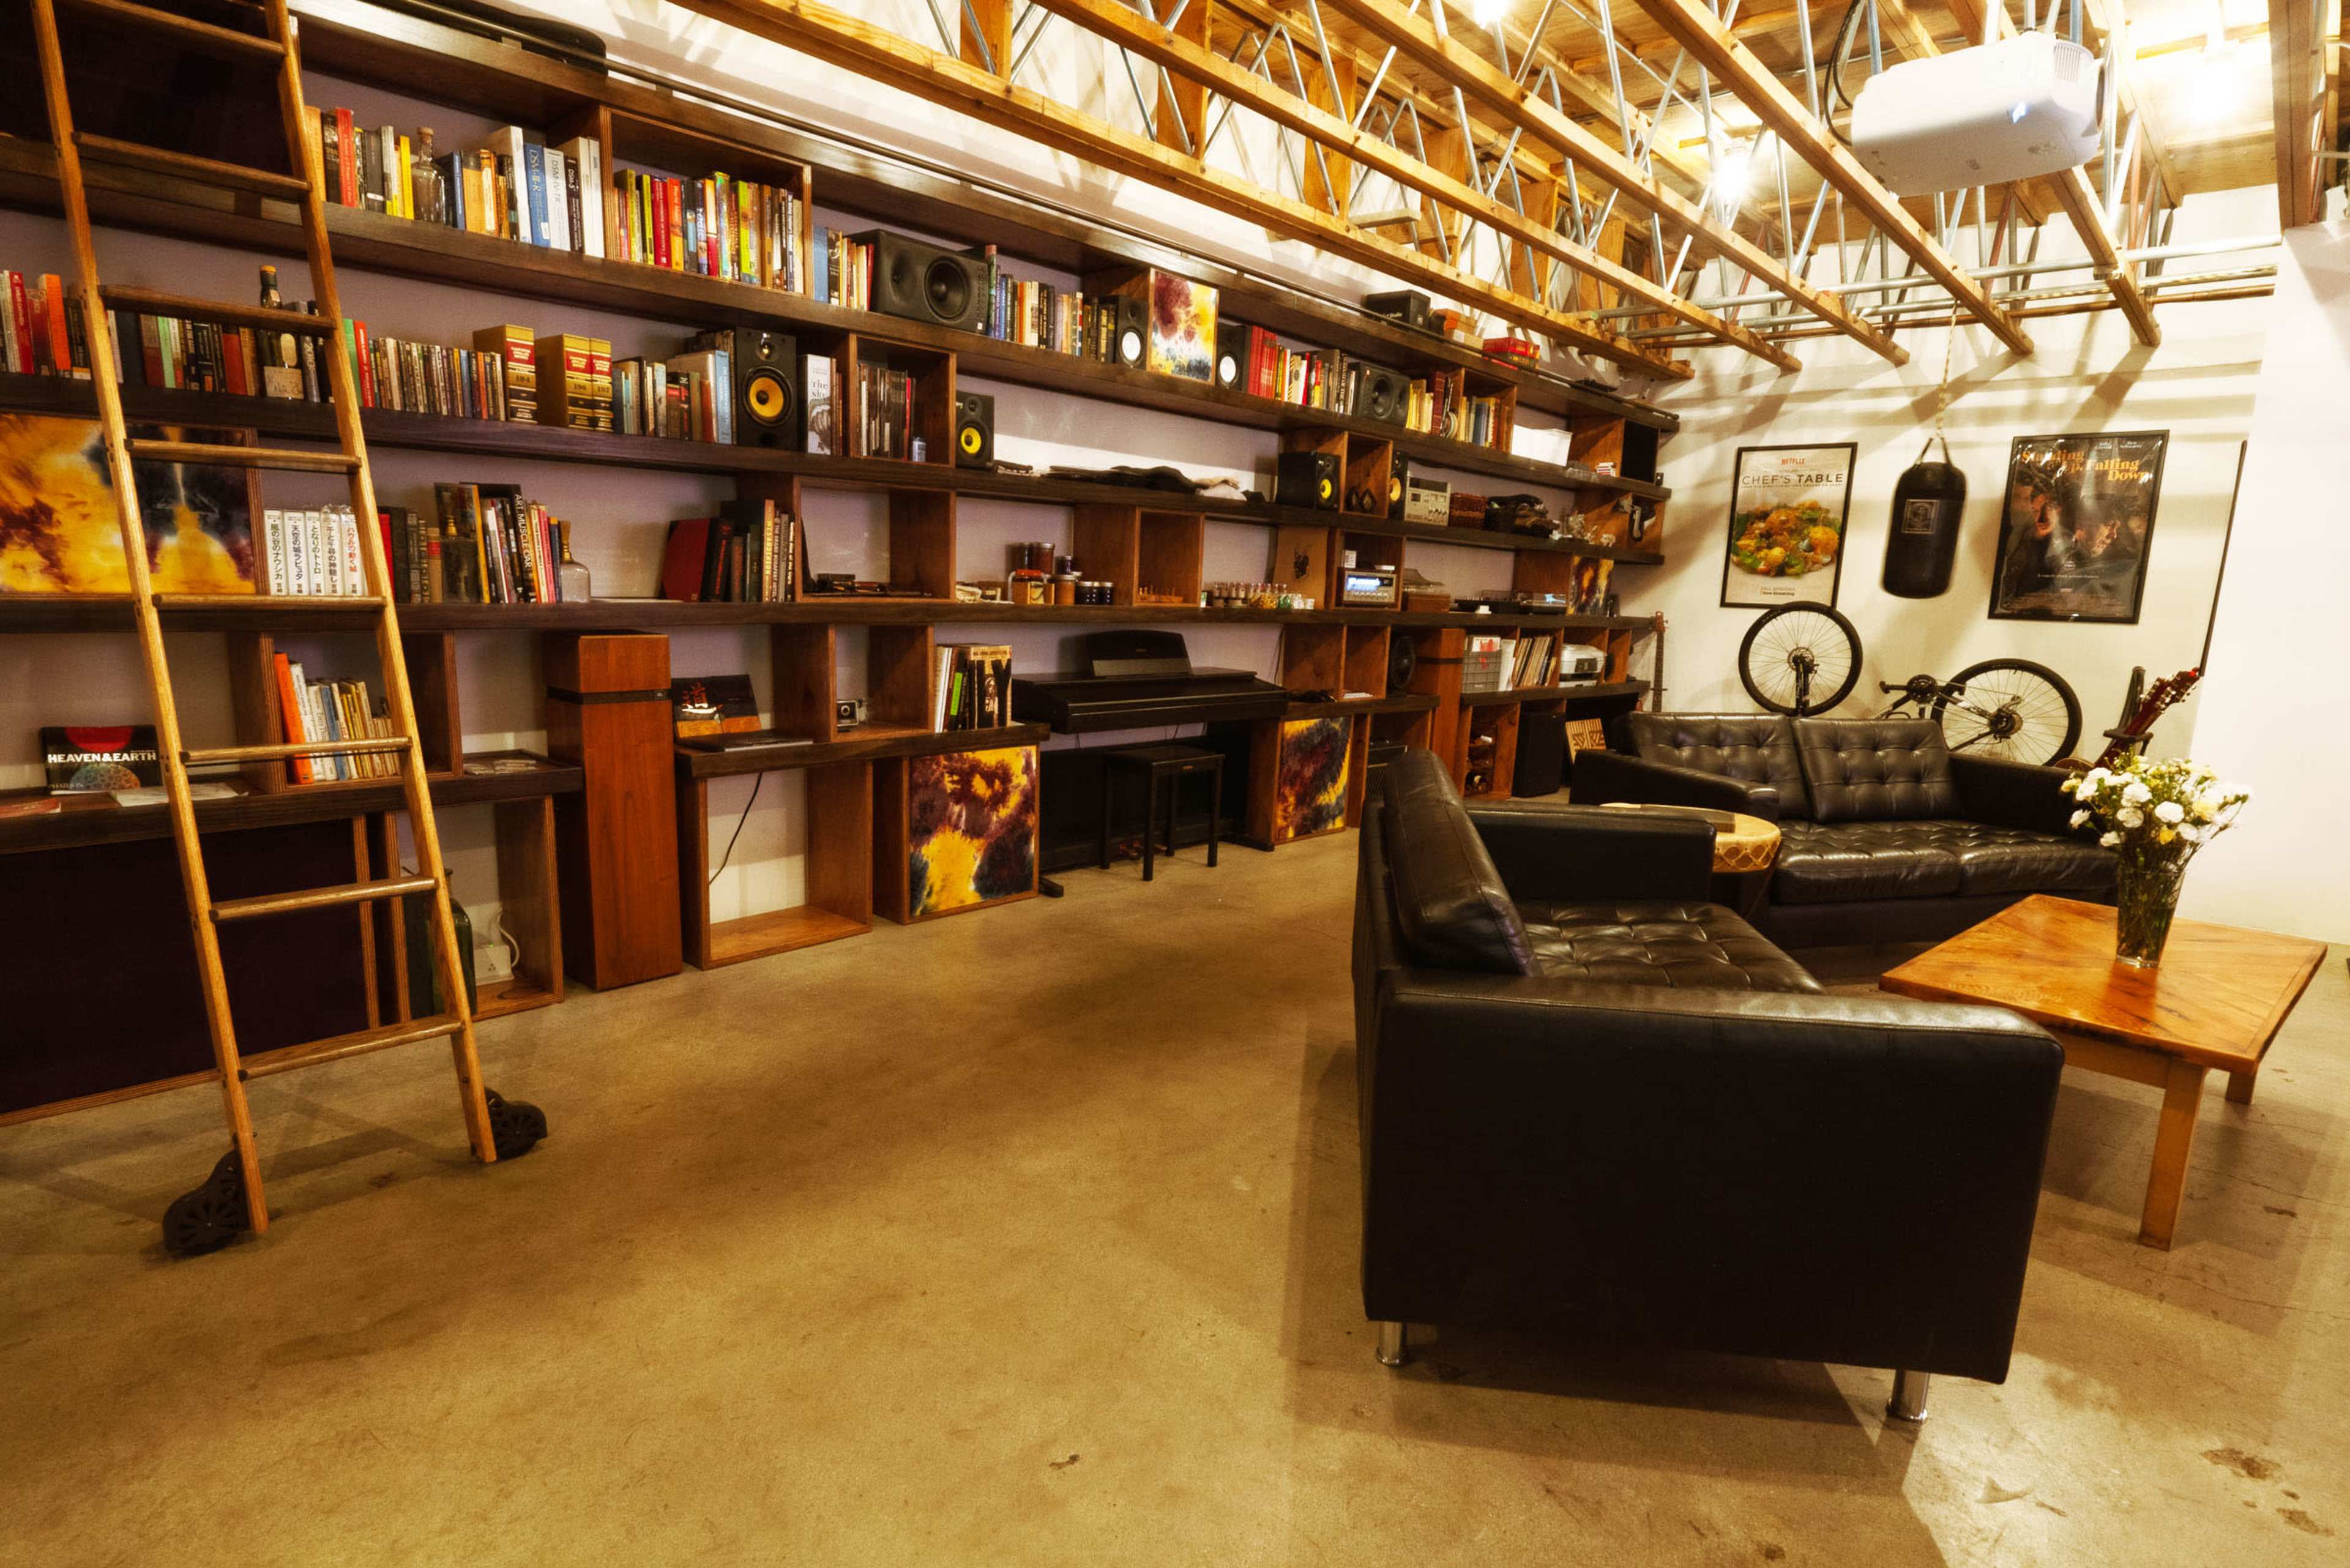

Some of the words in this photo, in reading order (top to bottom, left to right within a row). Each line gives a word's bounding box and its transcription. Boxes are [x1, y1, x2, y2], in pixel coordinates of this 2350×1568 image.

[2021, 449, 2084, 463] Stading
[2086, 458, 2140, 471] Falling
[1742, 474, 1791, 485] CHEF'S
[1796, 474, 1843, 484] TABLE
[514, 493, 523, 510] ART
[518, 513, 530, 548] MUSCLE
[270, 523, 282, 580] 風の谷のナウシカ
[291, 525, 304, 580] 天空の城ラピュタ
[311, 526, 321, 574] となりのトトロ
[524, 548, 534, 568] CAR
